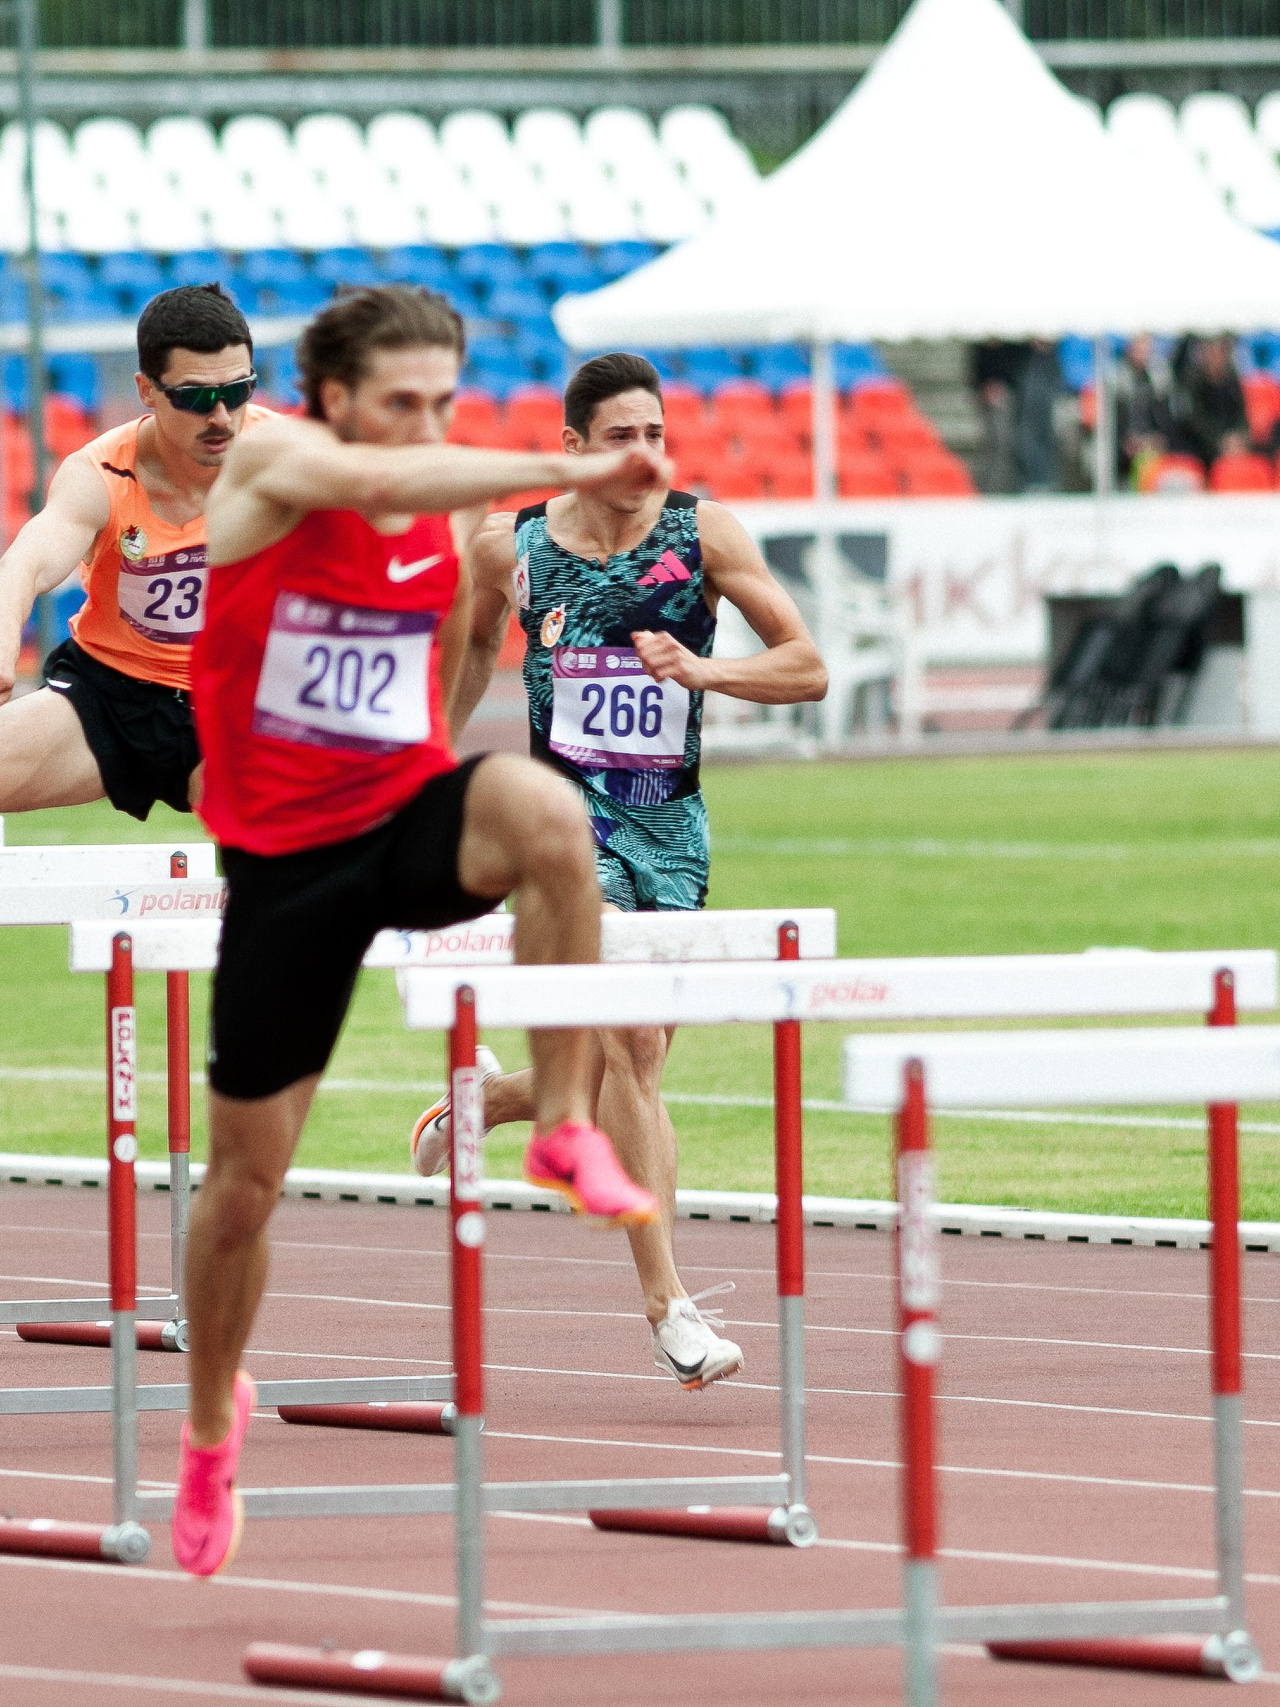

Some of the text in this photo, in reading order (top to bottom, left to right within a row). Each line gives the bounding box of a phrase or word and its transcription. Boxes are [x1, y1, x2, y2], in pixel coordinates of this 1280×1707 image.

[144, 576, 202, 621] 23
[298, 645, 397, 715] 202
[581, 683, 664, 738] 266
[117, 1013, 134, 1108] POLANIK
